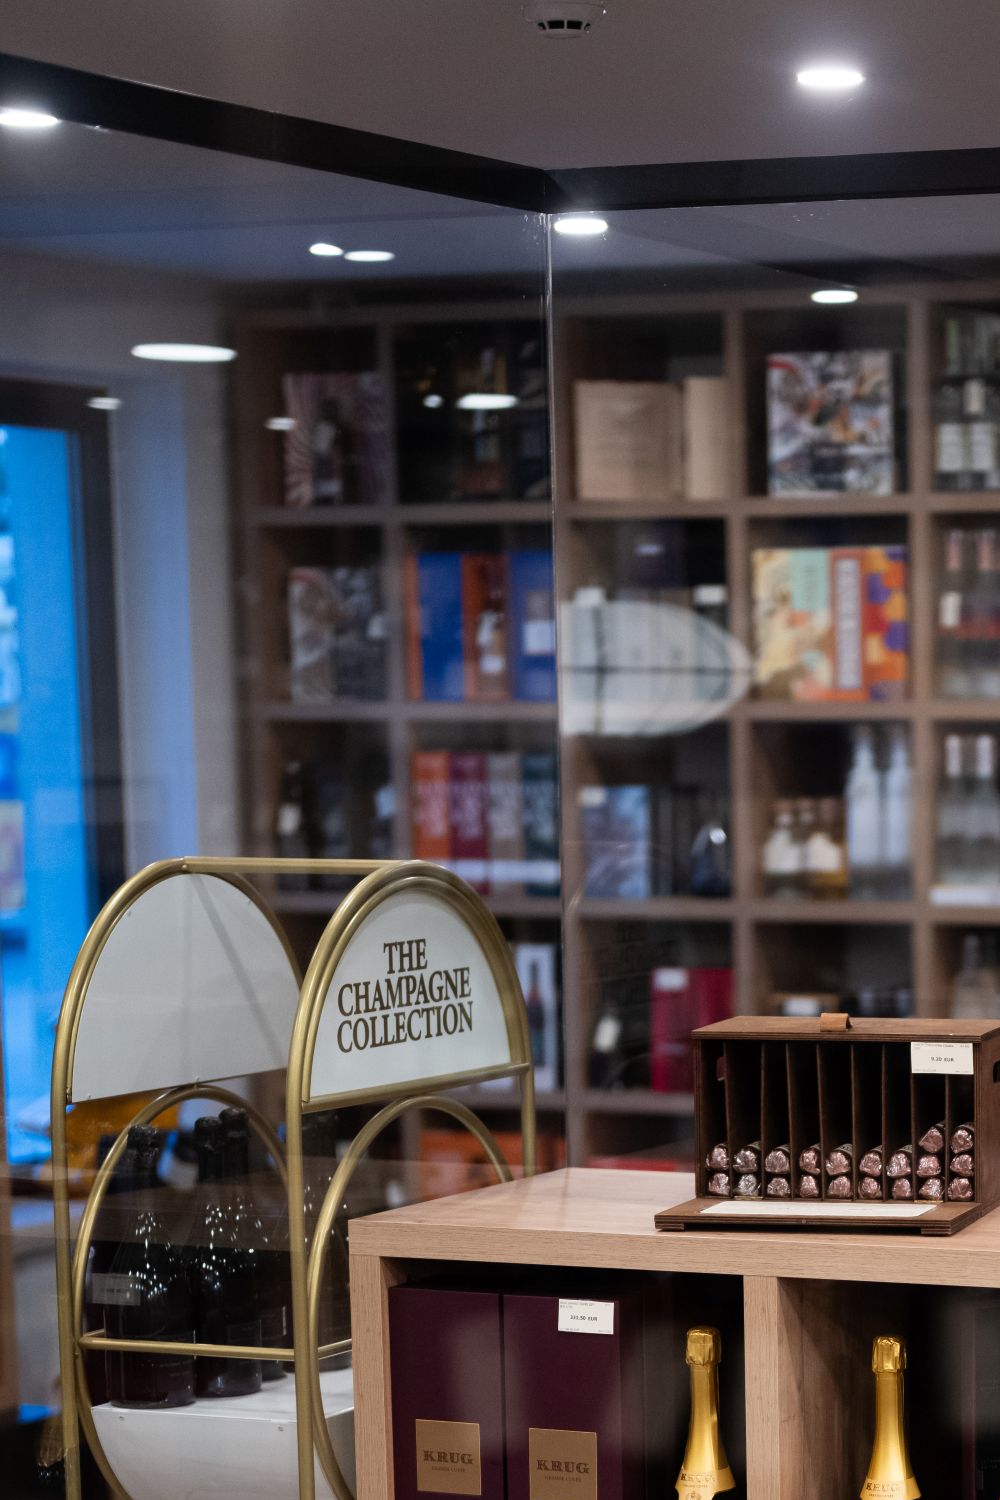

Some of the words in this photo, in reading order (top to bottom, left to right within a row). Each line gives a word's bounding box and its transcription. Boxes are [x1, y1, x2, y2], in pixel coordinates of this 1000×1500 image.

[384, 939, 427, 974] THE
[338, 967, 471, 1016] CHAMPAGNE
[337, 1001, 473, 1053] COLLECTION
[424, 1450, 473, 1465] KRUG
[536, 1459, 590, 1474] KRUG
